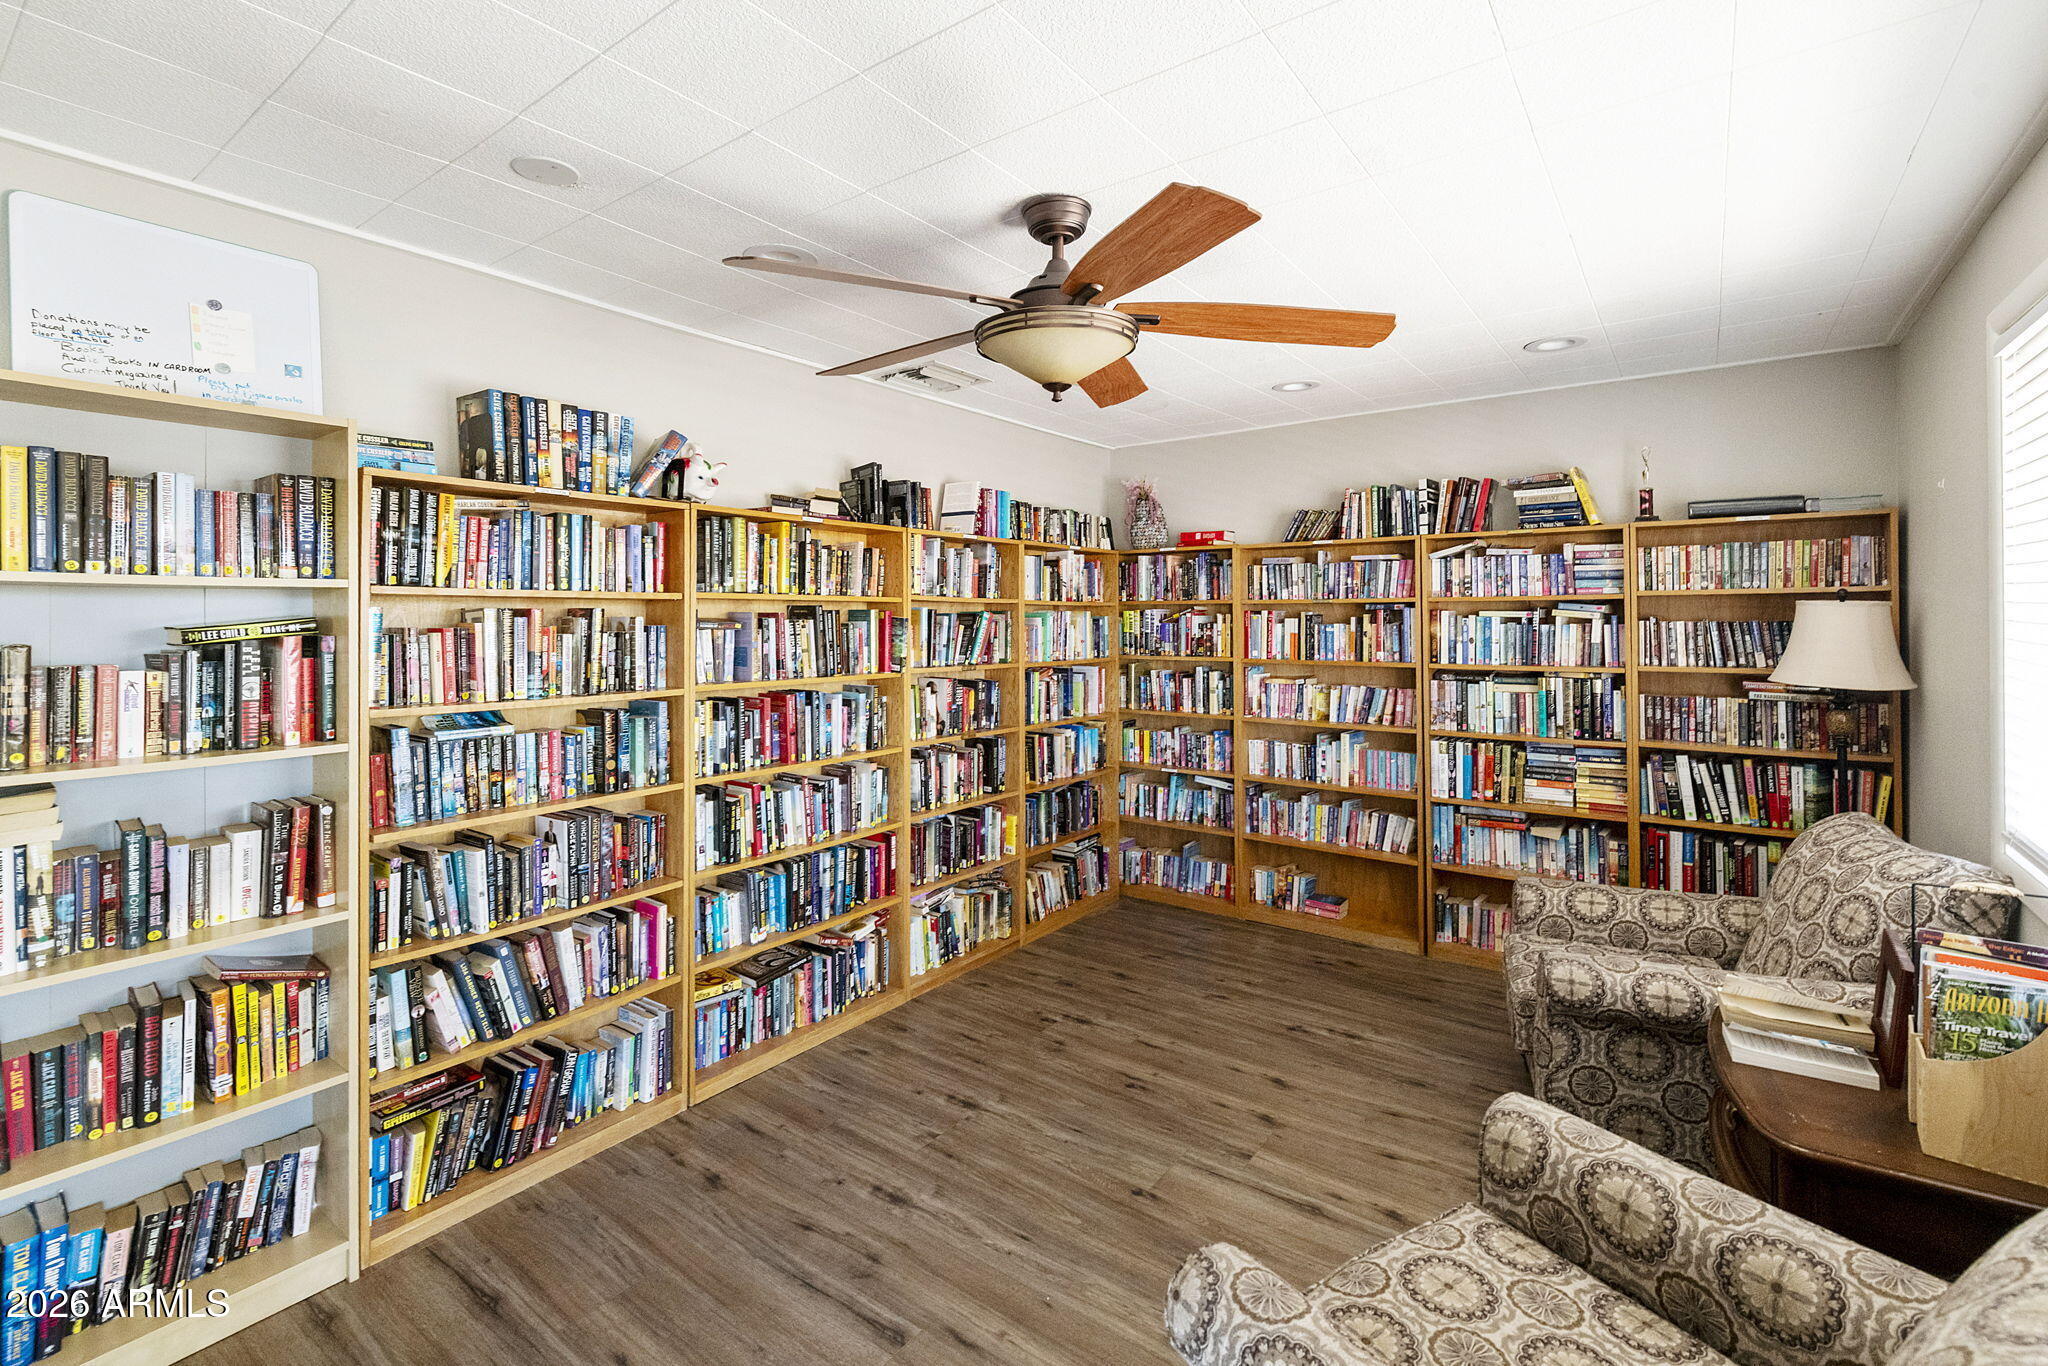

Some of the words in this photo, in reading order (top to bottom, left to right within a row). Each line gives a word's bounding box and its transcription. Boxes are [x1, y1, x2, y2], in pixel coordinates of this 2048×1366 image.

[494, 392, 502, 412] CLIVE
[538, 404, 547, 421] CLIVE
[494, 412, 503, 441] CUSSLER
[511, 412, 519, 437] CUSSLER
[582, 416, 591, 434] CLIVE
[596, 413, 604, 430] CLIVE
[362, 436, 388, 444] CUSSLER
[540, 422, 548, 450] CUSSLER
[622, 434, 630, 456] CUSSLER
[583, 435, 591, 462] CUSSLER
[36, 461, 47, 481] DAVID
[65, 456, 76, 476] DAVID
[92, 459, 104, 480] DAVID
[496, 451, 505, 476] PIRATE
[36, 483, 47, 516] BALDACCI
[65, 478, 76, 510] BALDACCI
[92, 482, 104, 514] BALDACCI
[136, 488, 148, 510] DAVID
[299, 479, 314, 502] DAVID
[320, 488, 333, 513] DAVID
[390, 492, 400, 510] HARLAN
[410, 489, 420, 508] HARLAN
[299, 504, 314, 541] BALDACCI
[390, 511, 400, 527] COBEN
[410, 509, 420, 524] COBEN
[136, 512, 148, 547] BALDACCI
[202, 631, 219, 640] LEE
[220, 628, 246, 638] CHILD
[242, 647, 252, 676] BELL
[250, 650, 260, 672] TED
[606, 713, 616, 733] Nelson
[274, 813, 282, 850] JUDGMENT
[324, 830, 332, 844] THE
[570, 822, 578, 844] VINCE
[592, 818, 600, 840] VINCE
[128, 843, 139, 870] SANDRA
[570, 845, 578, 866] FLYNN
[592, 840, 600, 860] FLYNN
[194, 861, 204, 883] SANDRA
[274, 874, 283, 884] W.
[128, 871, 140, 896] BROWN
[273, 884, 283, 905] BUFFA
[130, 897, 140, 934] OVERKILL
[236, 994, 246, 1004] LEE
[460, 963, 468, 976] LISA
[465, 976, 478, 1000] GARDNER
[474, 1001, 484, 1018] NEVER
[216, 1004, 228, 1014] LEE
[1944, 988, 2028, 1019] ARIZONA
[144, 1016, 160, 1038] BAD
[238, 1007, 246, 1028] CHILD
[1944, 1020, 1982, 1035] Time
[1984, 1026, 2033, 1042] Travel
[1950, 1032, 1978, 1052] 15
[121, 1048, 134, 1084] MISSIONARY
[144, 1040, 159, 1076] BLOOD
[566, 1052, 578, 1068] JOHN
[10, 1070, 24, 1090] JACK
[42, 1062, 56, 1080] JACK
[560, 1068, 574, 1096] GRISHAM
[11, 1090, 24, 1111] CARR
[42, 1081, 56, 1100] CARR
[383, 1110, 416, 1130] Griffin
[280, 1157, 294, 1173] TOM
[250, 1170, 259, 1184] TOM
[276, 1173, 292, 1200] CLANCY
[301, 1165, 312, 1190] CLANCY
[242, 1184, 254, 1214] CLANCY
[12, 1244, 30, 1272] TOM
[45, 1234, 66, 1260] Tom
